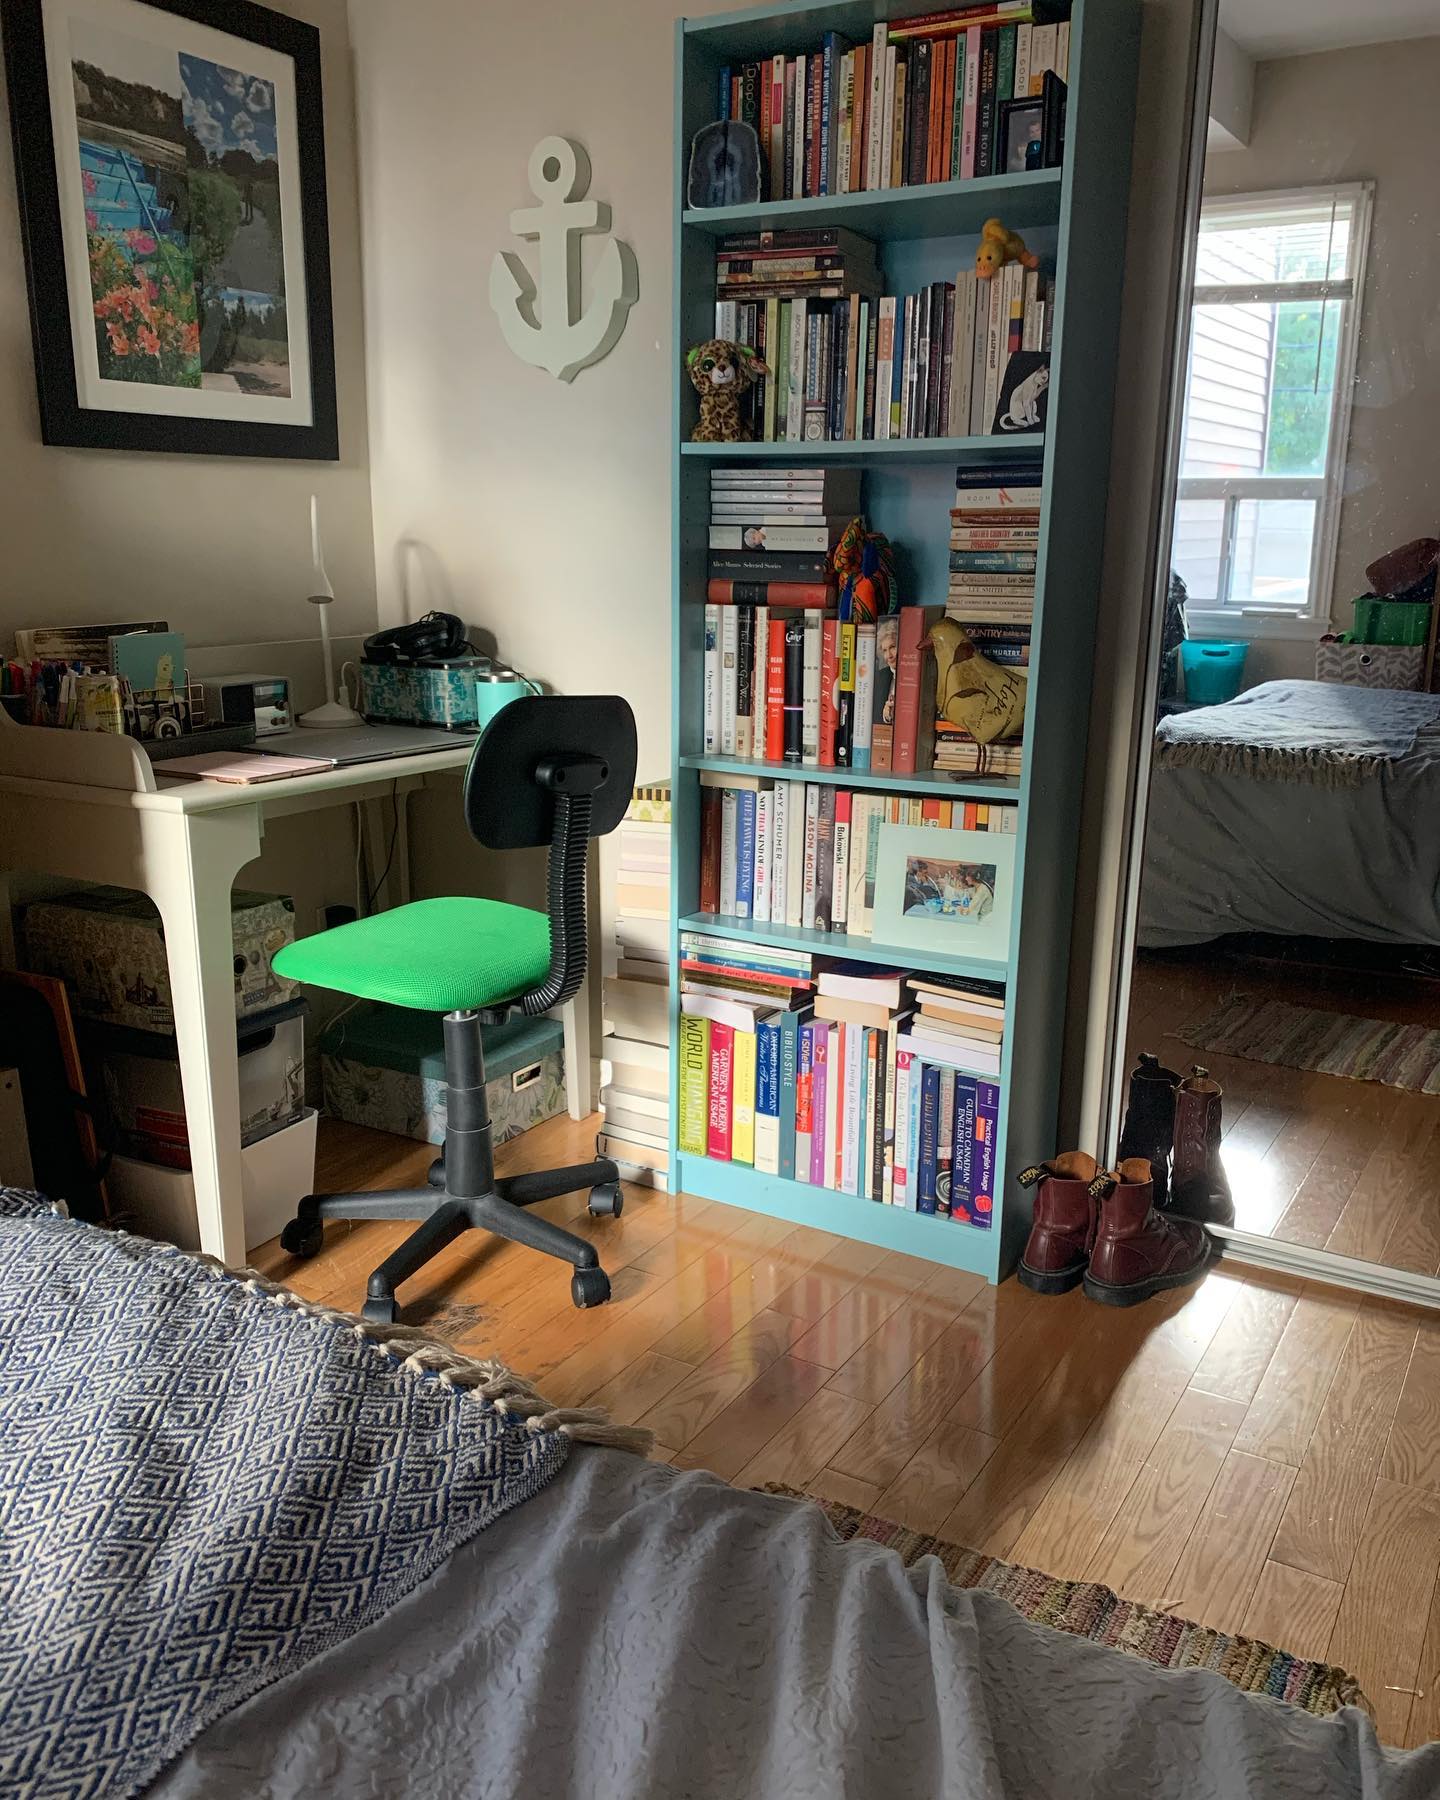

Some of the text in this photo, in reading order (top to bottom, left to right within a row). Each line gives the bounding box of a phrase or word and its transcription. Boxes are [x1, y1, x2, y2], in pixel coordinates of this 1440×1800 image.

[824, 69, 830, 78] IN
[981, 48, 989, 93] McCARTHY
[1018, 58, 1026, 92] GOOD
[979, 103, 990, 167] THE ROAD
[820, 147, 828, 186] DARNIELLE
[992, 281, 1000, 302] CHARLES
[989, 330, 997, 369] HOLLYWOOD
[969, 530, 989, 538] ANOTHER
[989, 530, 1010, 538] COUNTRY
[712, 560, 782, 570] Alice Munro Selected Stories
[739, 641, 752, 657] Love
[740, 630, 749, 641] The
[736, 669, 748, 687] Good
[770, 656, 783, 664] DEAR
[705, 670, 714, 716] Open Secrets
[738, 687, 747, 710] Woman
[820, 631, 832, 755] BLACKOUTS
[984, 672, 1020, 718] Hope
[758, 812, 766, 833] THAT
[775, 785, 784, 860] AMY SCHUMER
[817, 818, 832, 841] HANK
[741, 793, 753, 893] THE HAWK IS DYING
[757, 855, 765, 866] OF
[758, 834, 766, 854] KIND
[805, 814, 815, 894] JASON MOLINA
[835, 825, 846, 864] Bukowski
[757, 866, 765, 884] GIRL
[710, 1049, 720, 1128] AMERICAN USAGE
[758, 1031, 769, 1109] Writer's Thesaurus
[768, 1031, 779, 1112] OXFORD AMERICAN
[886, 1063, 894, 1094] SCRAPBOOK
[718, 1048, 729, 1133] GARNER'S MODERN
[846, 1063, 857, 1146] Living Life Beautifully
[943, 1083, 952, 1130] LEGENDARY
[875, 1112, 883, 1134] YORK
[923, 1092, 936, 1166] BIBLIOPHILE
[955, 1107, 966, 1171] ENGLISH USAGE
[963, 1098, 974, 1184] GUIDE TO CANADIAN
[874, 1135, 882, 1176] DRAWINGS
[980, 1118, 994, 1192] Practical English Usage
